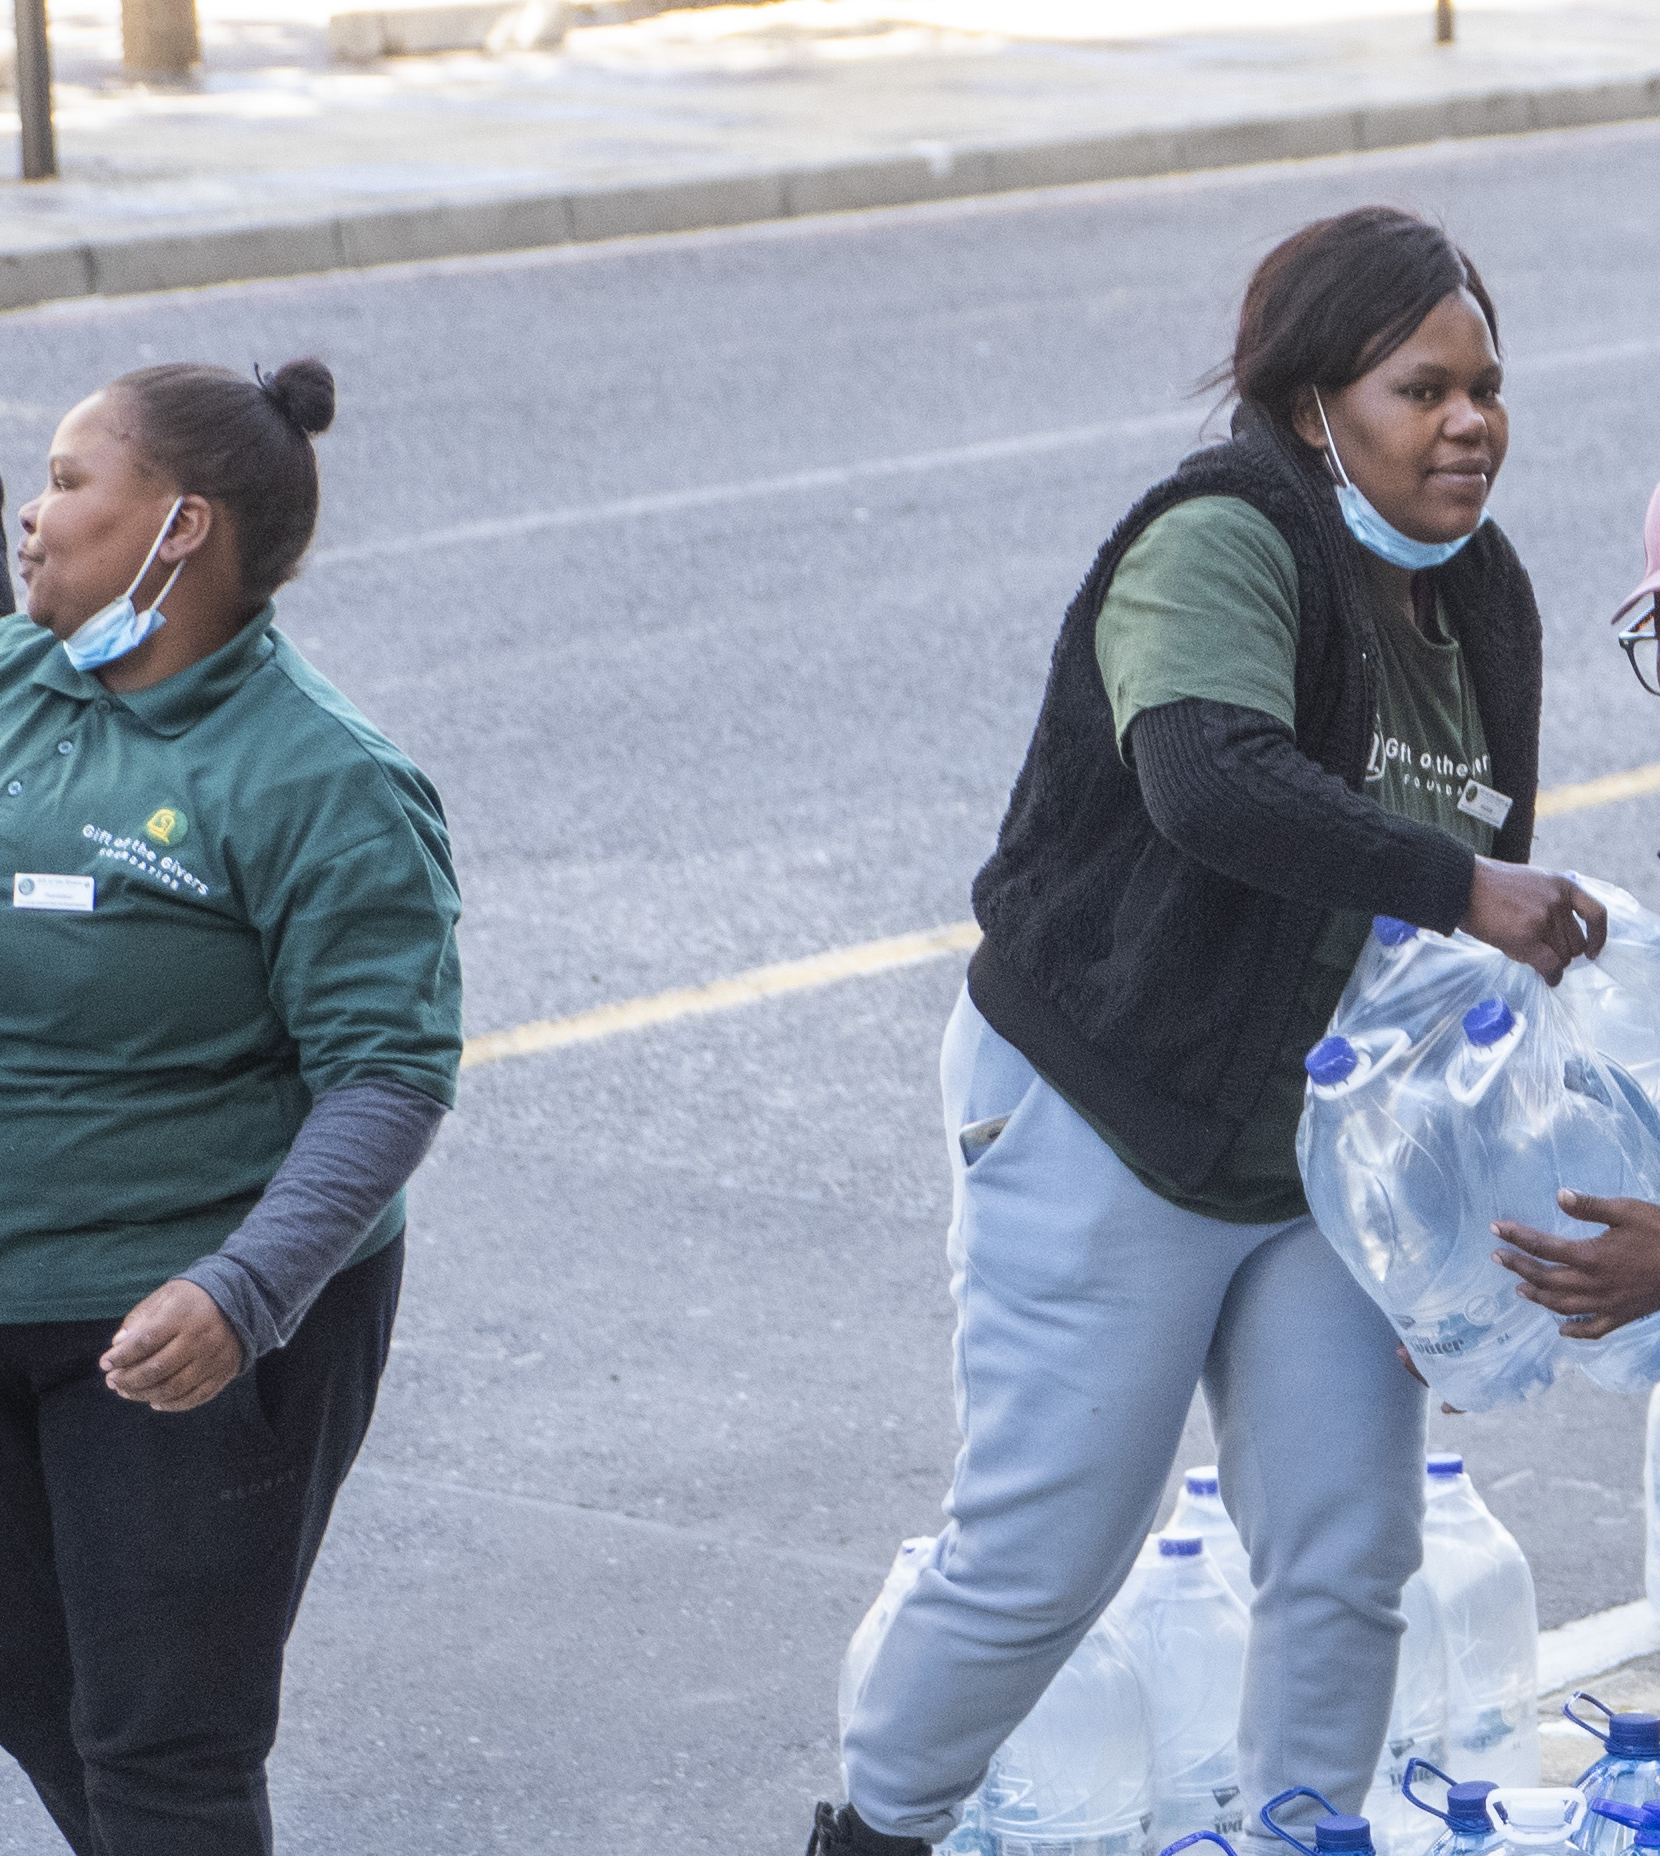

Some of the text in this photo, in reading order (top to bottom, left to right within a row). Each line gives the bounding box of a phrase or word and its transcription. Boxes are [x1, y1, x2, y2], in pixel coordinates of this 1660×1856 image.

[83, 823, 209, 896] Gift of the Givers
